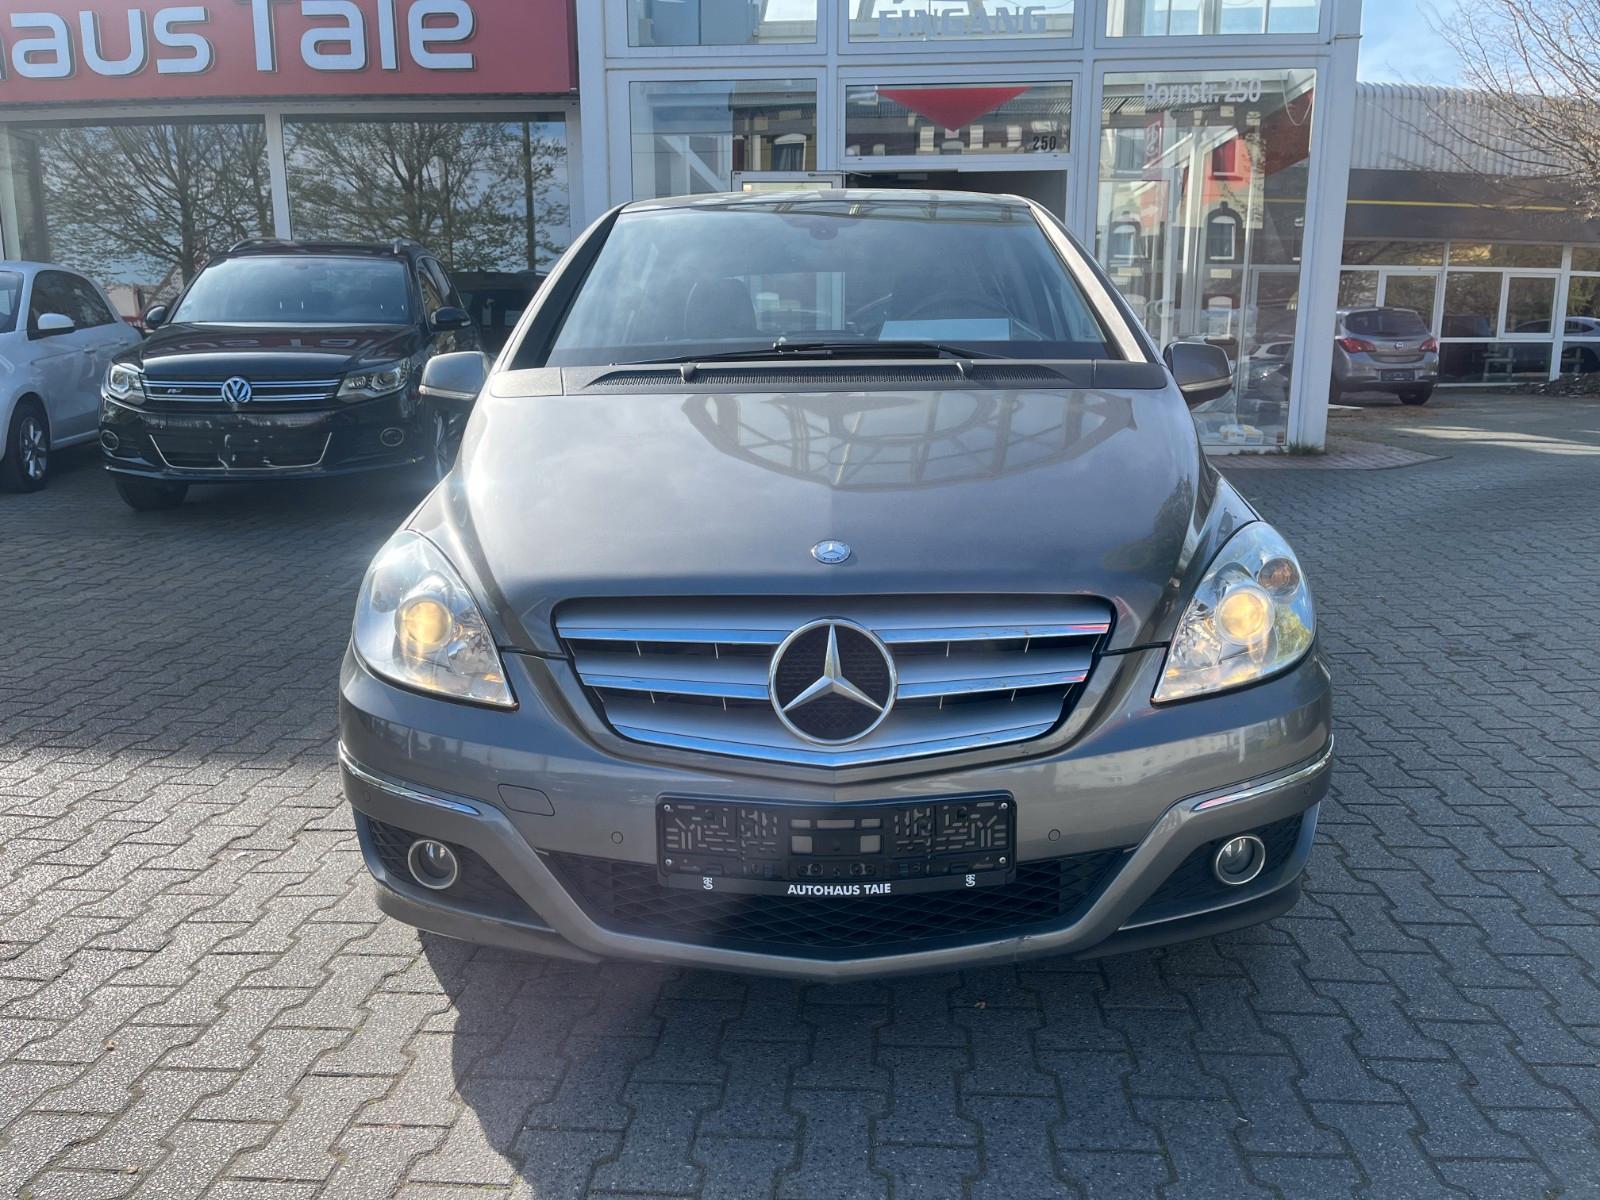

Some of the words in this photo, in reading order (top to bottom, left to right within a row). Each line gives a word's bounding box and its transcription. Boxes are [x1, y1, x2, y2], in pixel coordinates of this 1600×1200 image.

[878, 6, 1047, 37] EINGANG
[0, 6, 213, 79] aus
[1144, 80, 1220, 104] Bornstr.
[1223, 79, 1261, 103] 250
[1032, 135, 1057, 151] 250
[787, 883, 861, 896] AUTOHAUS
[863, 883, 892, 895] TAIE
